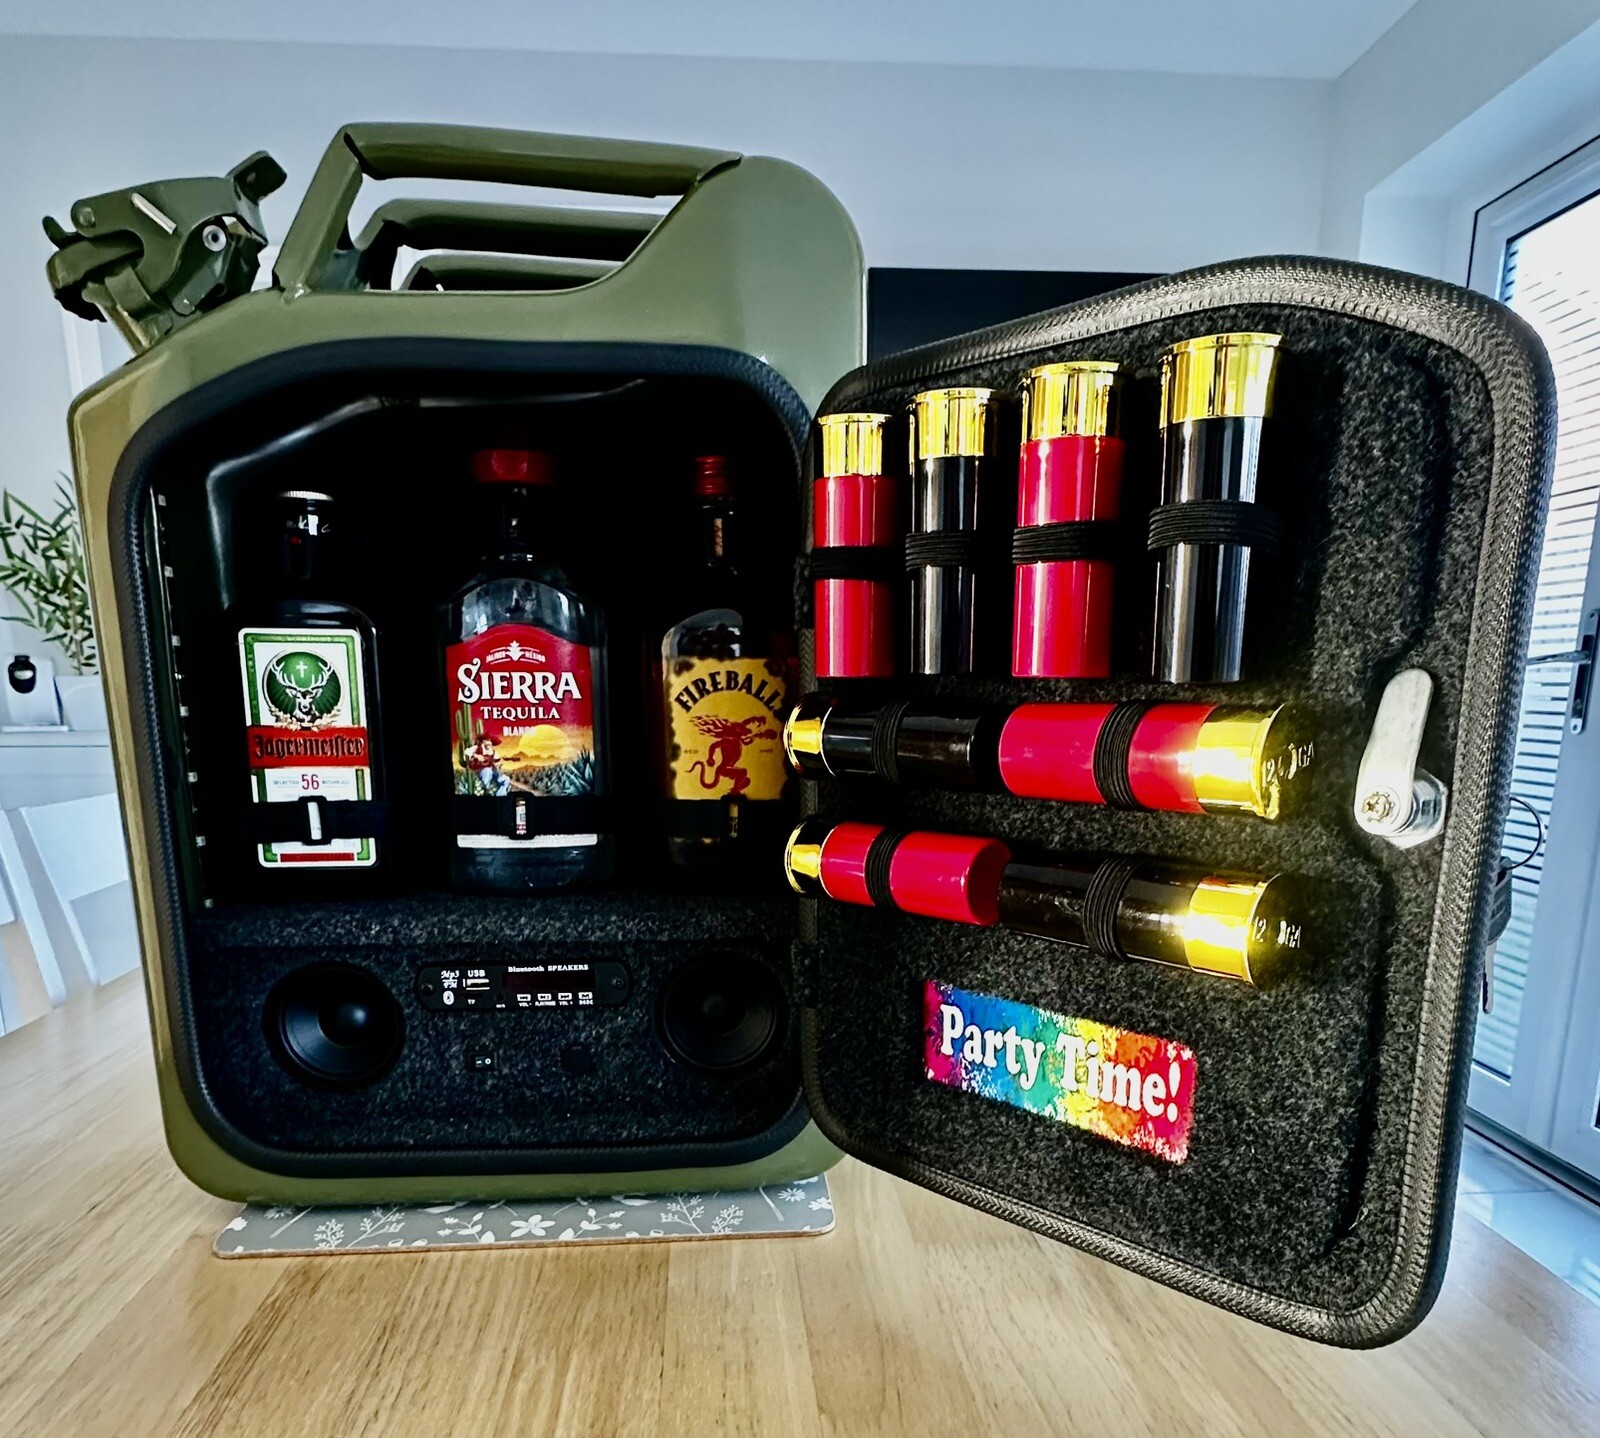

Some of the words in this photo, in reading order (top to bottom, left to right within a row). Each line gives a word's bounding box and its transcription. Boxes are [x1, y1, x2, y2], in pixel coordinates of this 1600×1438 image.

[457, 657, 582, 704] SIERRA
[674, 670, 781, 714] FIREBALL
[480, 706, 560, 721] TEQUILA
[301, 773, 320, 791] 56
[467, 969, 486, 977] USB
[547, 963, 589, 971] SPEAKERS
[940, 1004, 1046, 1091] Party
[1056, 1032, 1182, 1124] Time!
